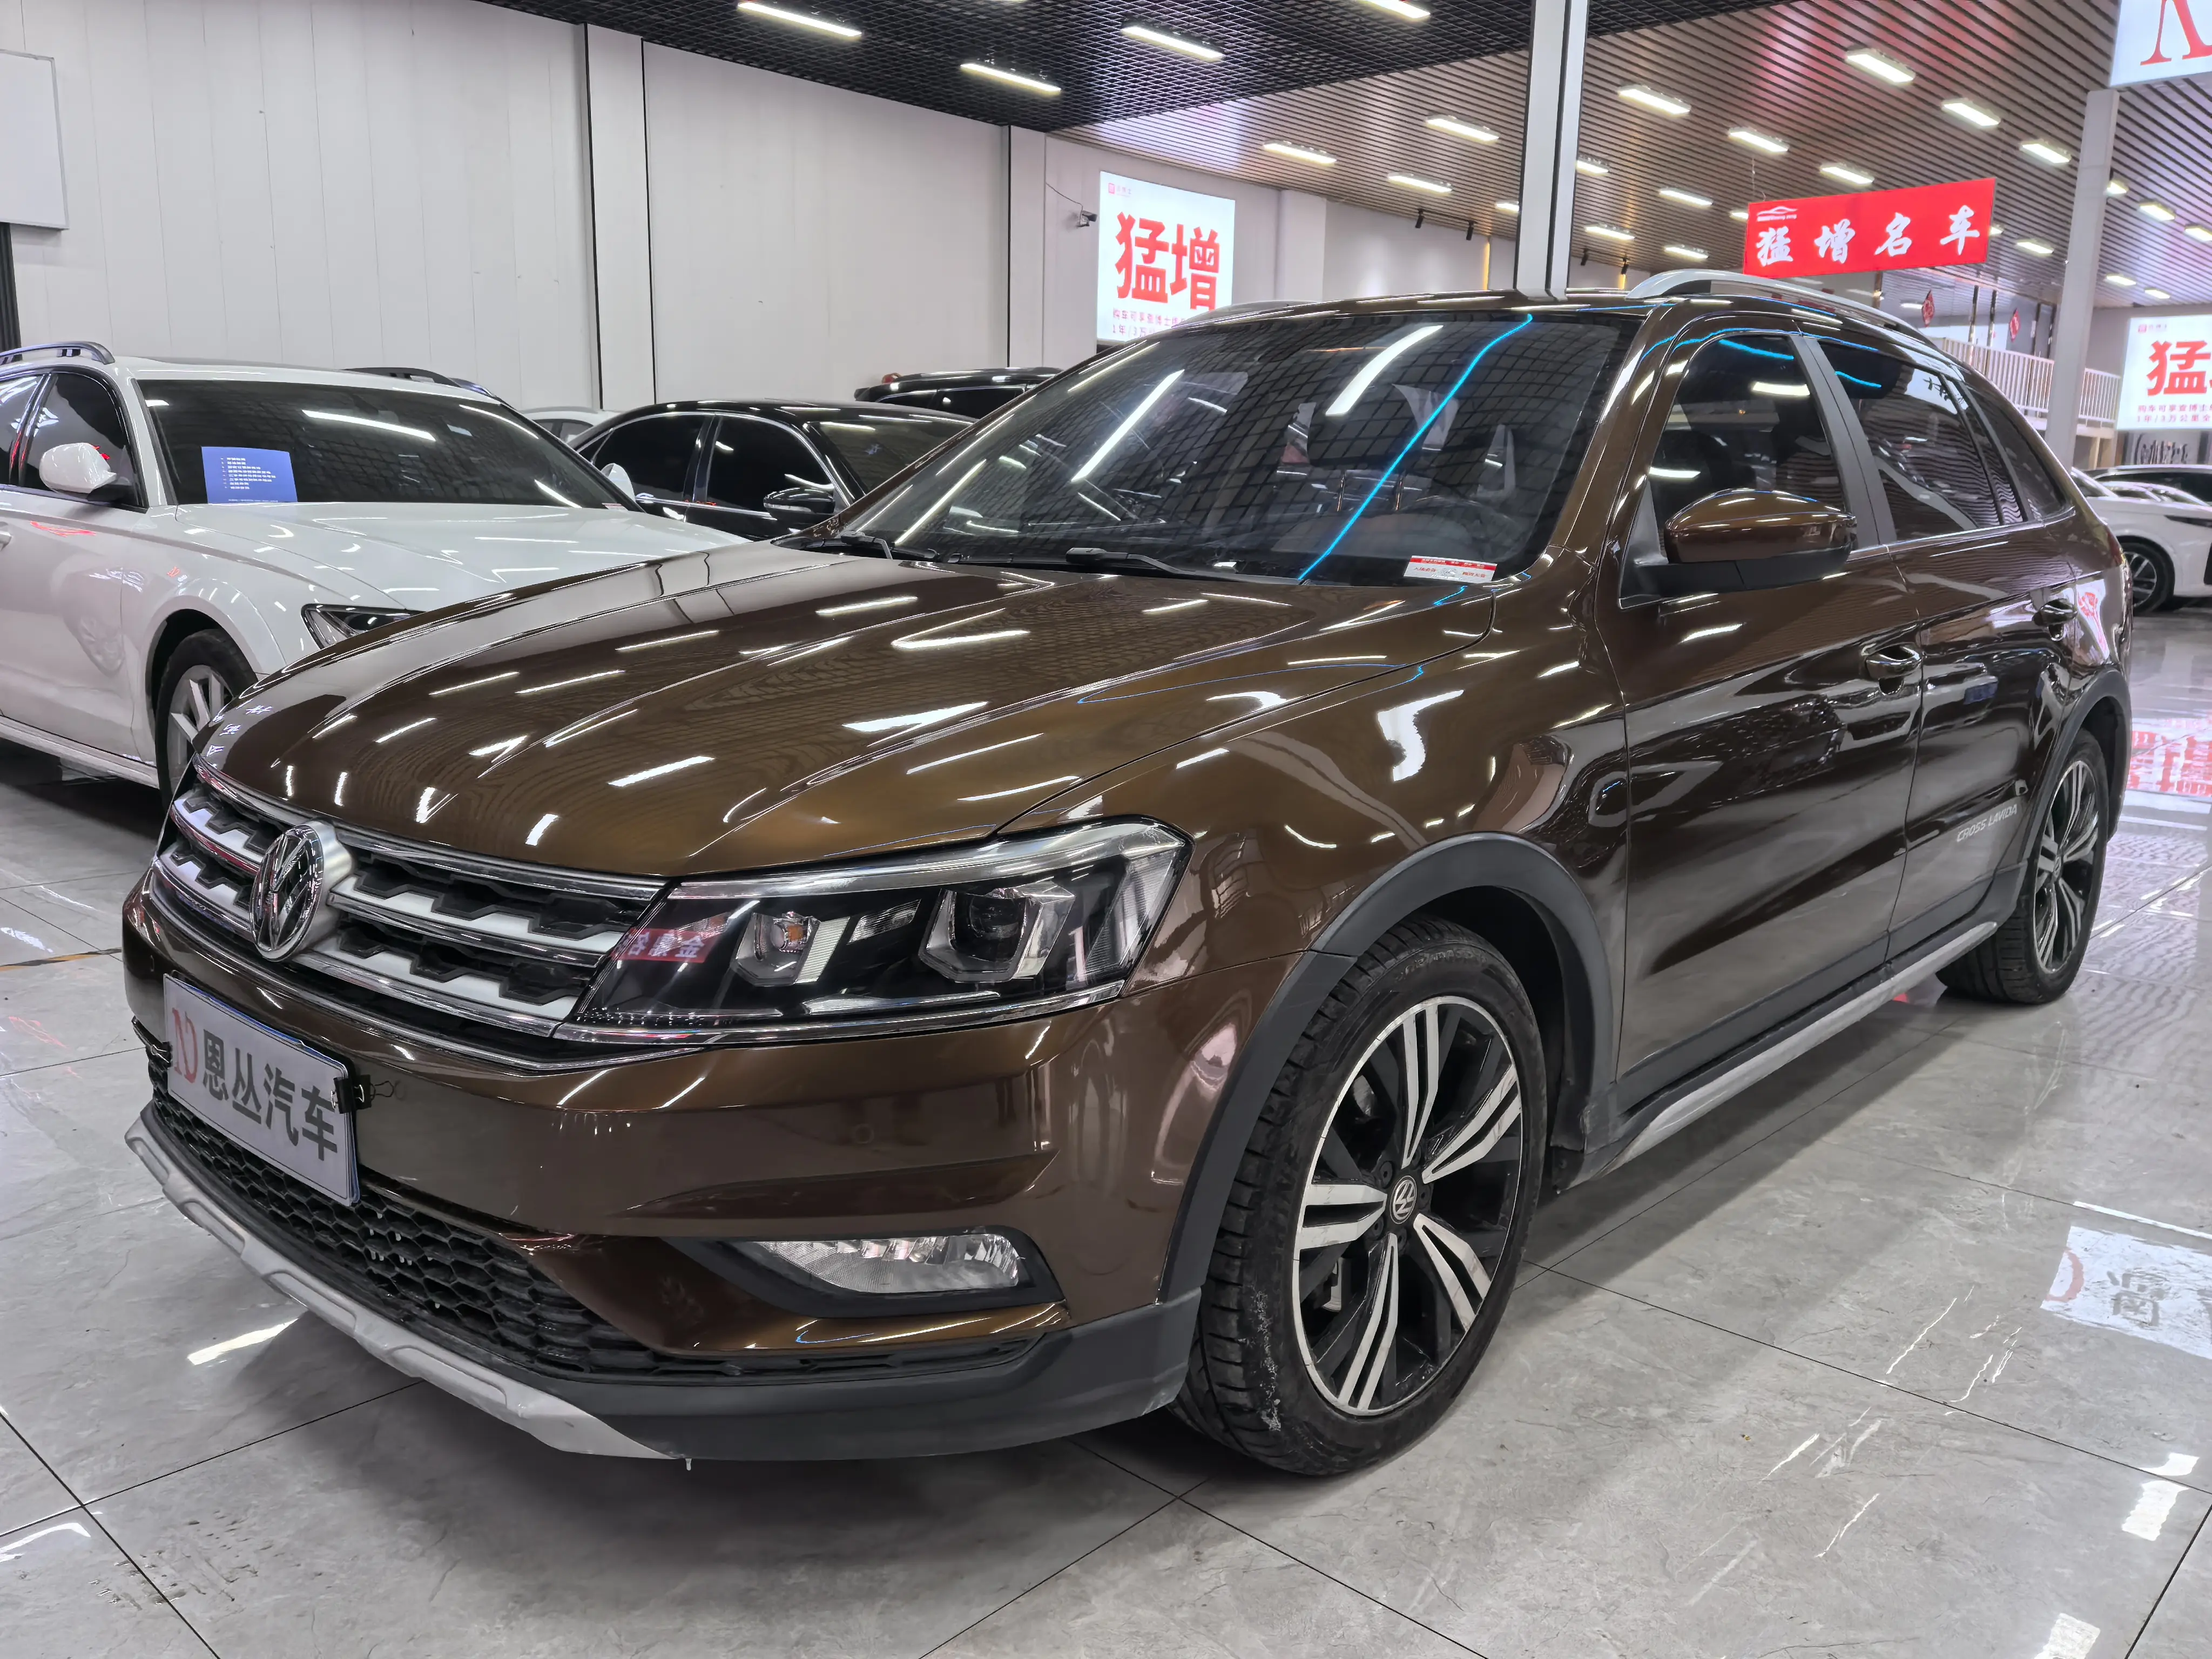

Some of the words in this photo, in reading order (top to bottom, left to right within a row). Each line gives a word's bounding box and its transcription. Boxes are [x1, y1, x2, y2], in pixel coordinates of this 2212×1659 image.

[1115, 211, 1220, 311] 猛增
[1756, 205, 1980, 267] 猛增名车
[2146, 340, 2212, 397] 猛
[1957, 819, 1987, 842] CROSS
[1988, 804, 2018, 826] LAVIDA
[203, 1029, 338, 1162] 恩丛汽车
